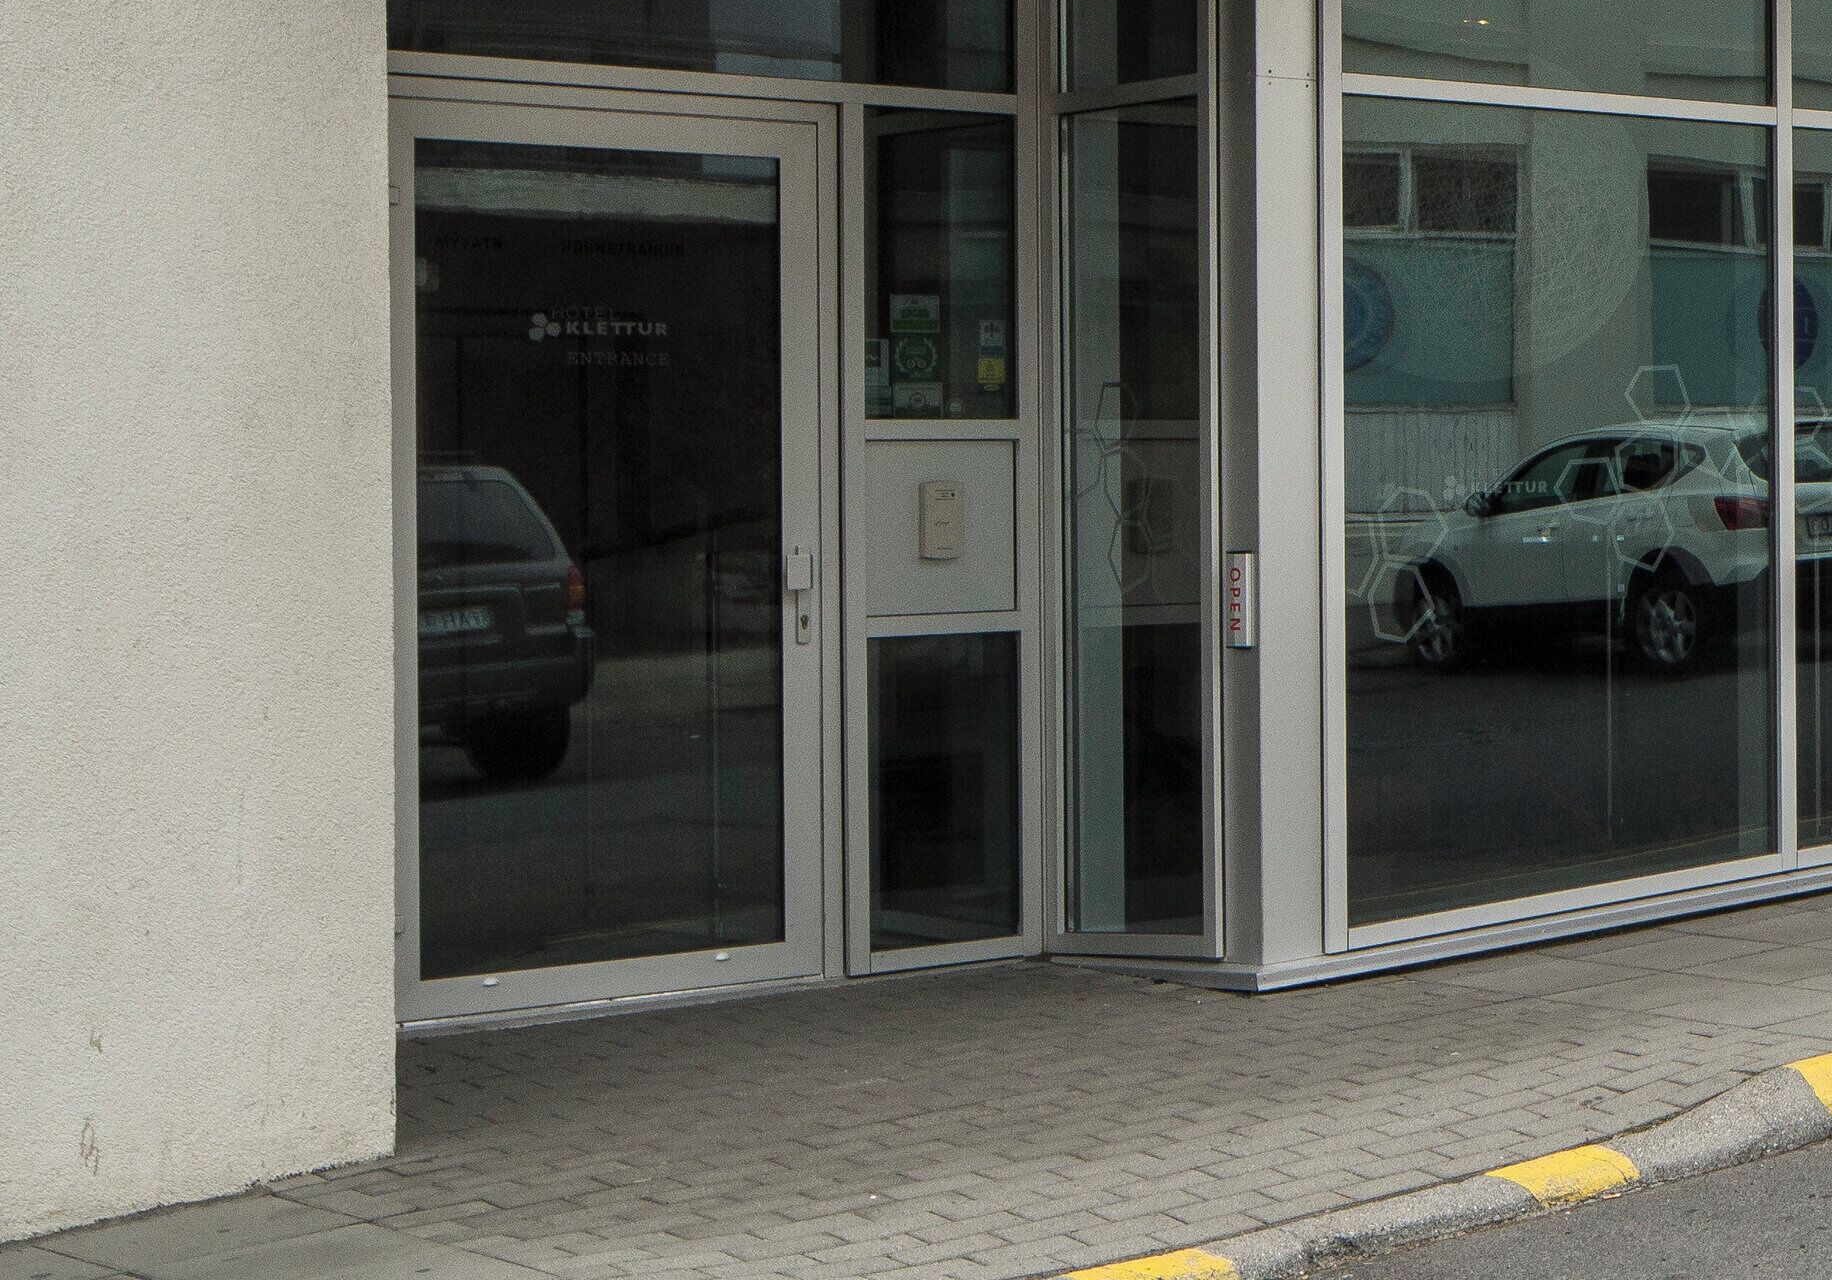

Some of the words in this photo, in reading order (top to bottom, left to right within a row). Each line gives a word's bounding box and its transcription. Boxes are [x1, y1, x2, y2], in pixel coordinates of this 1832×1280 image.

[566, 320, 668, 337] KLETTUR
[567, 350, 670, 367] ENTRANCE
[1229, 567, 1241, 631] OPEN
